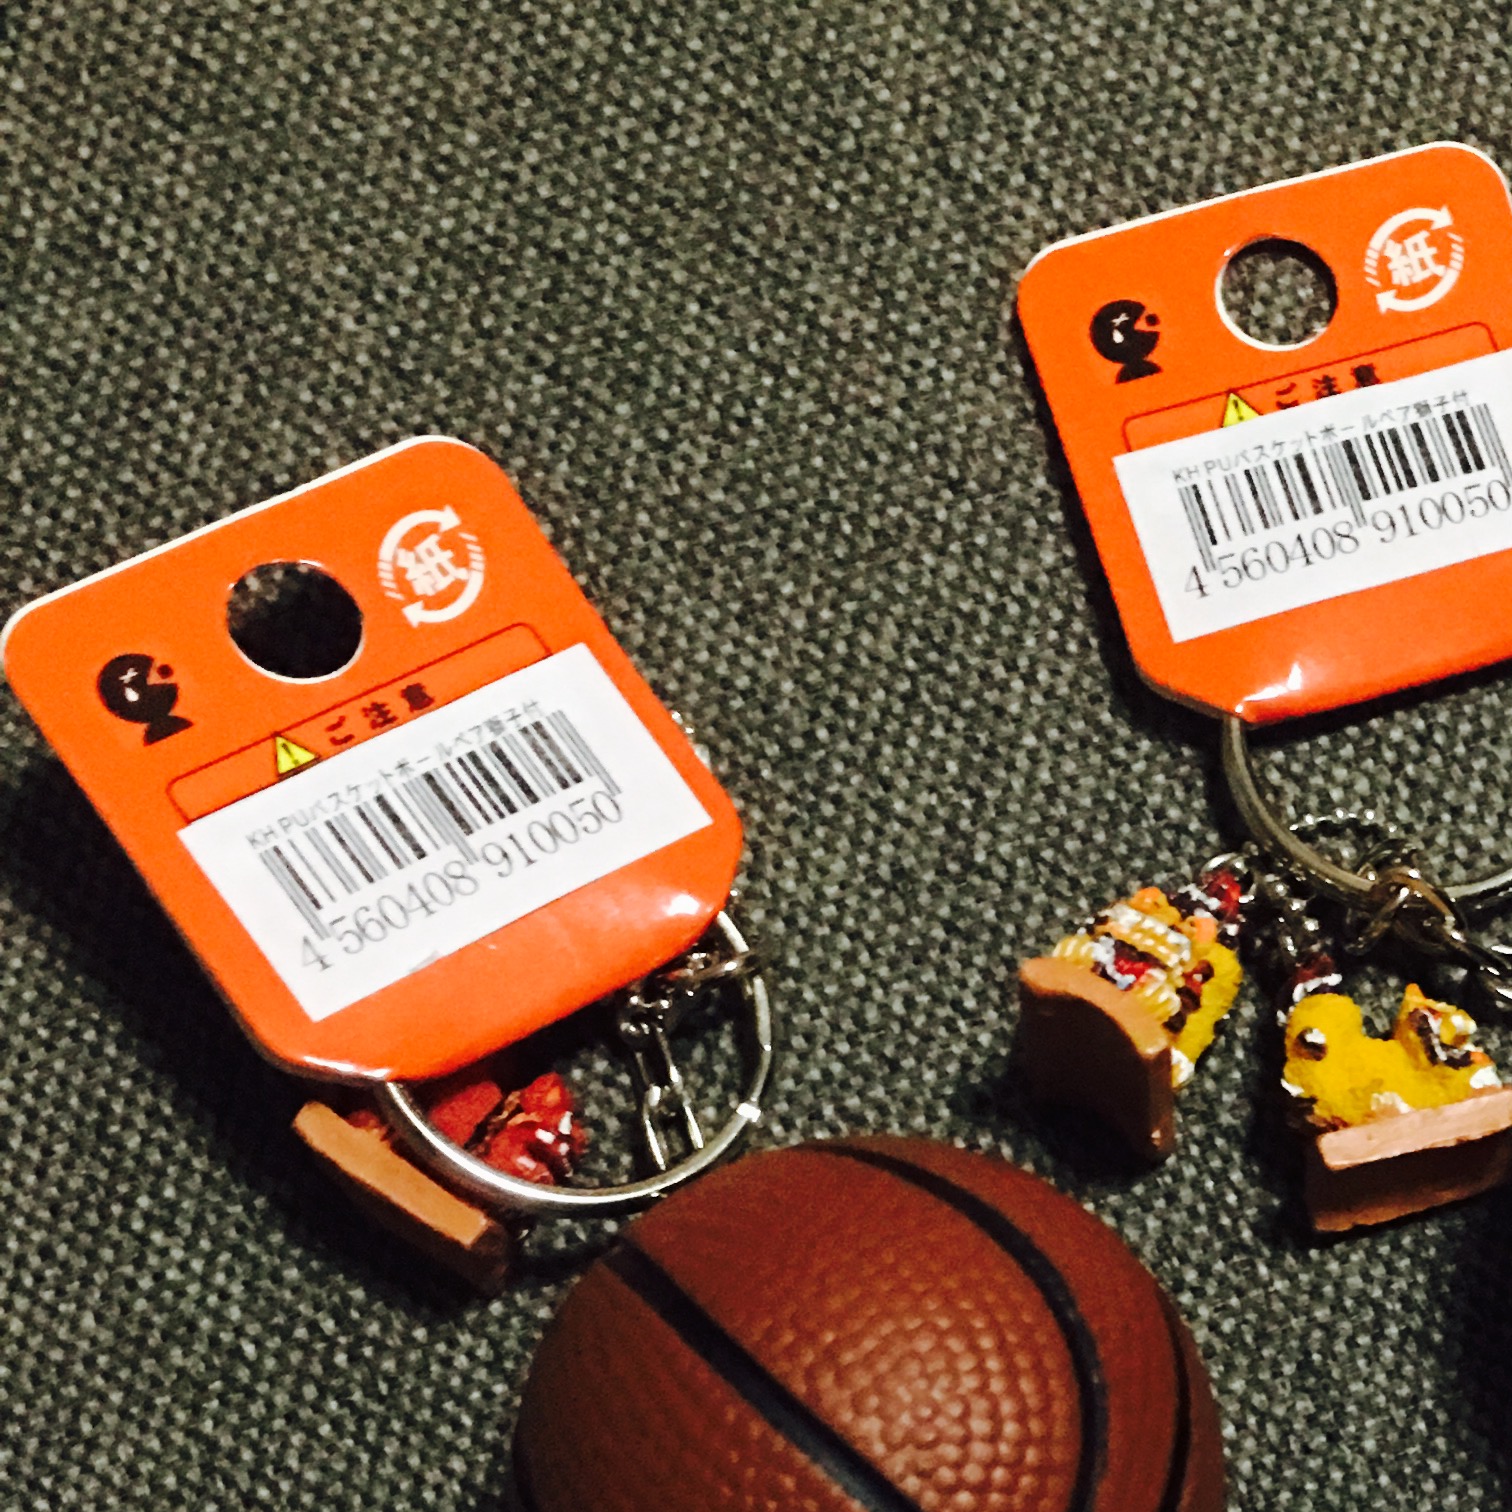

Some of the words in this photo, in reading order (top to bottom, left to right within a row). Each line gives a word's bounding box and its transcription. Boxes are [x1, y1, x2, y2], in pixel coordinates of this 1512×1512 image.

[1385, 230, 1444, 287] 紙
[1173, 464, 1200, 483] KH
[398, 532, 469, 603] 紙
[246, 826, 277, 849] KH
